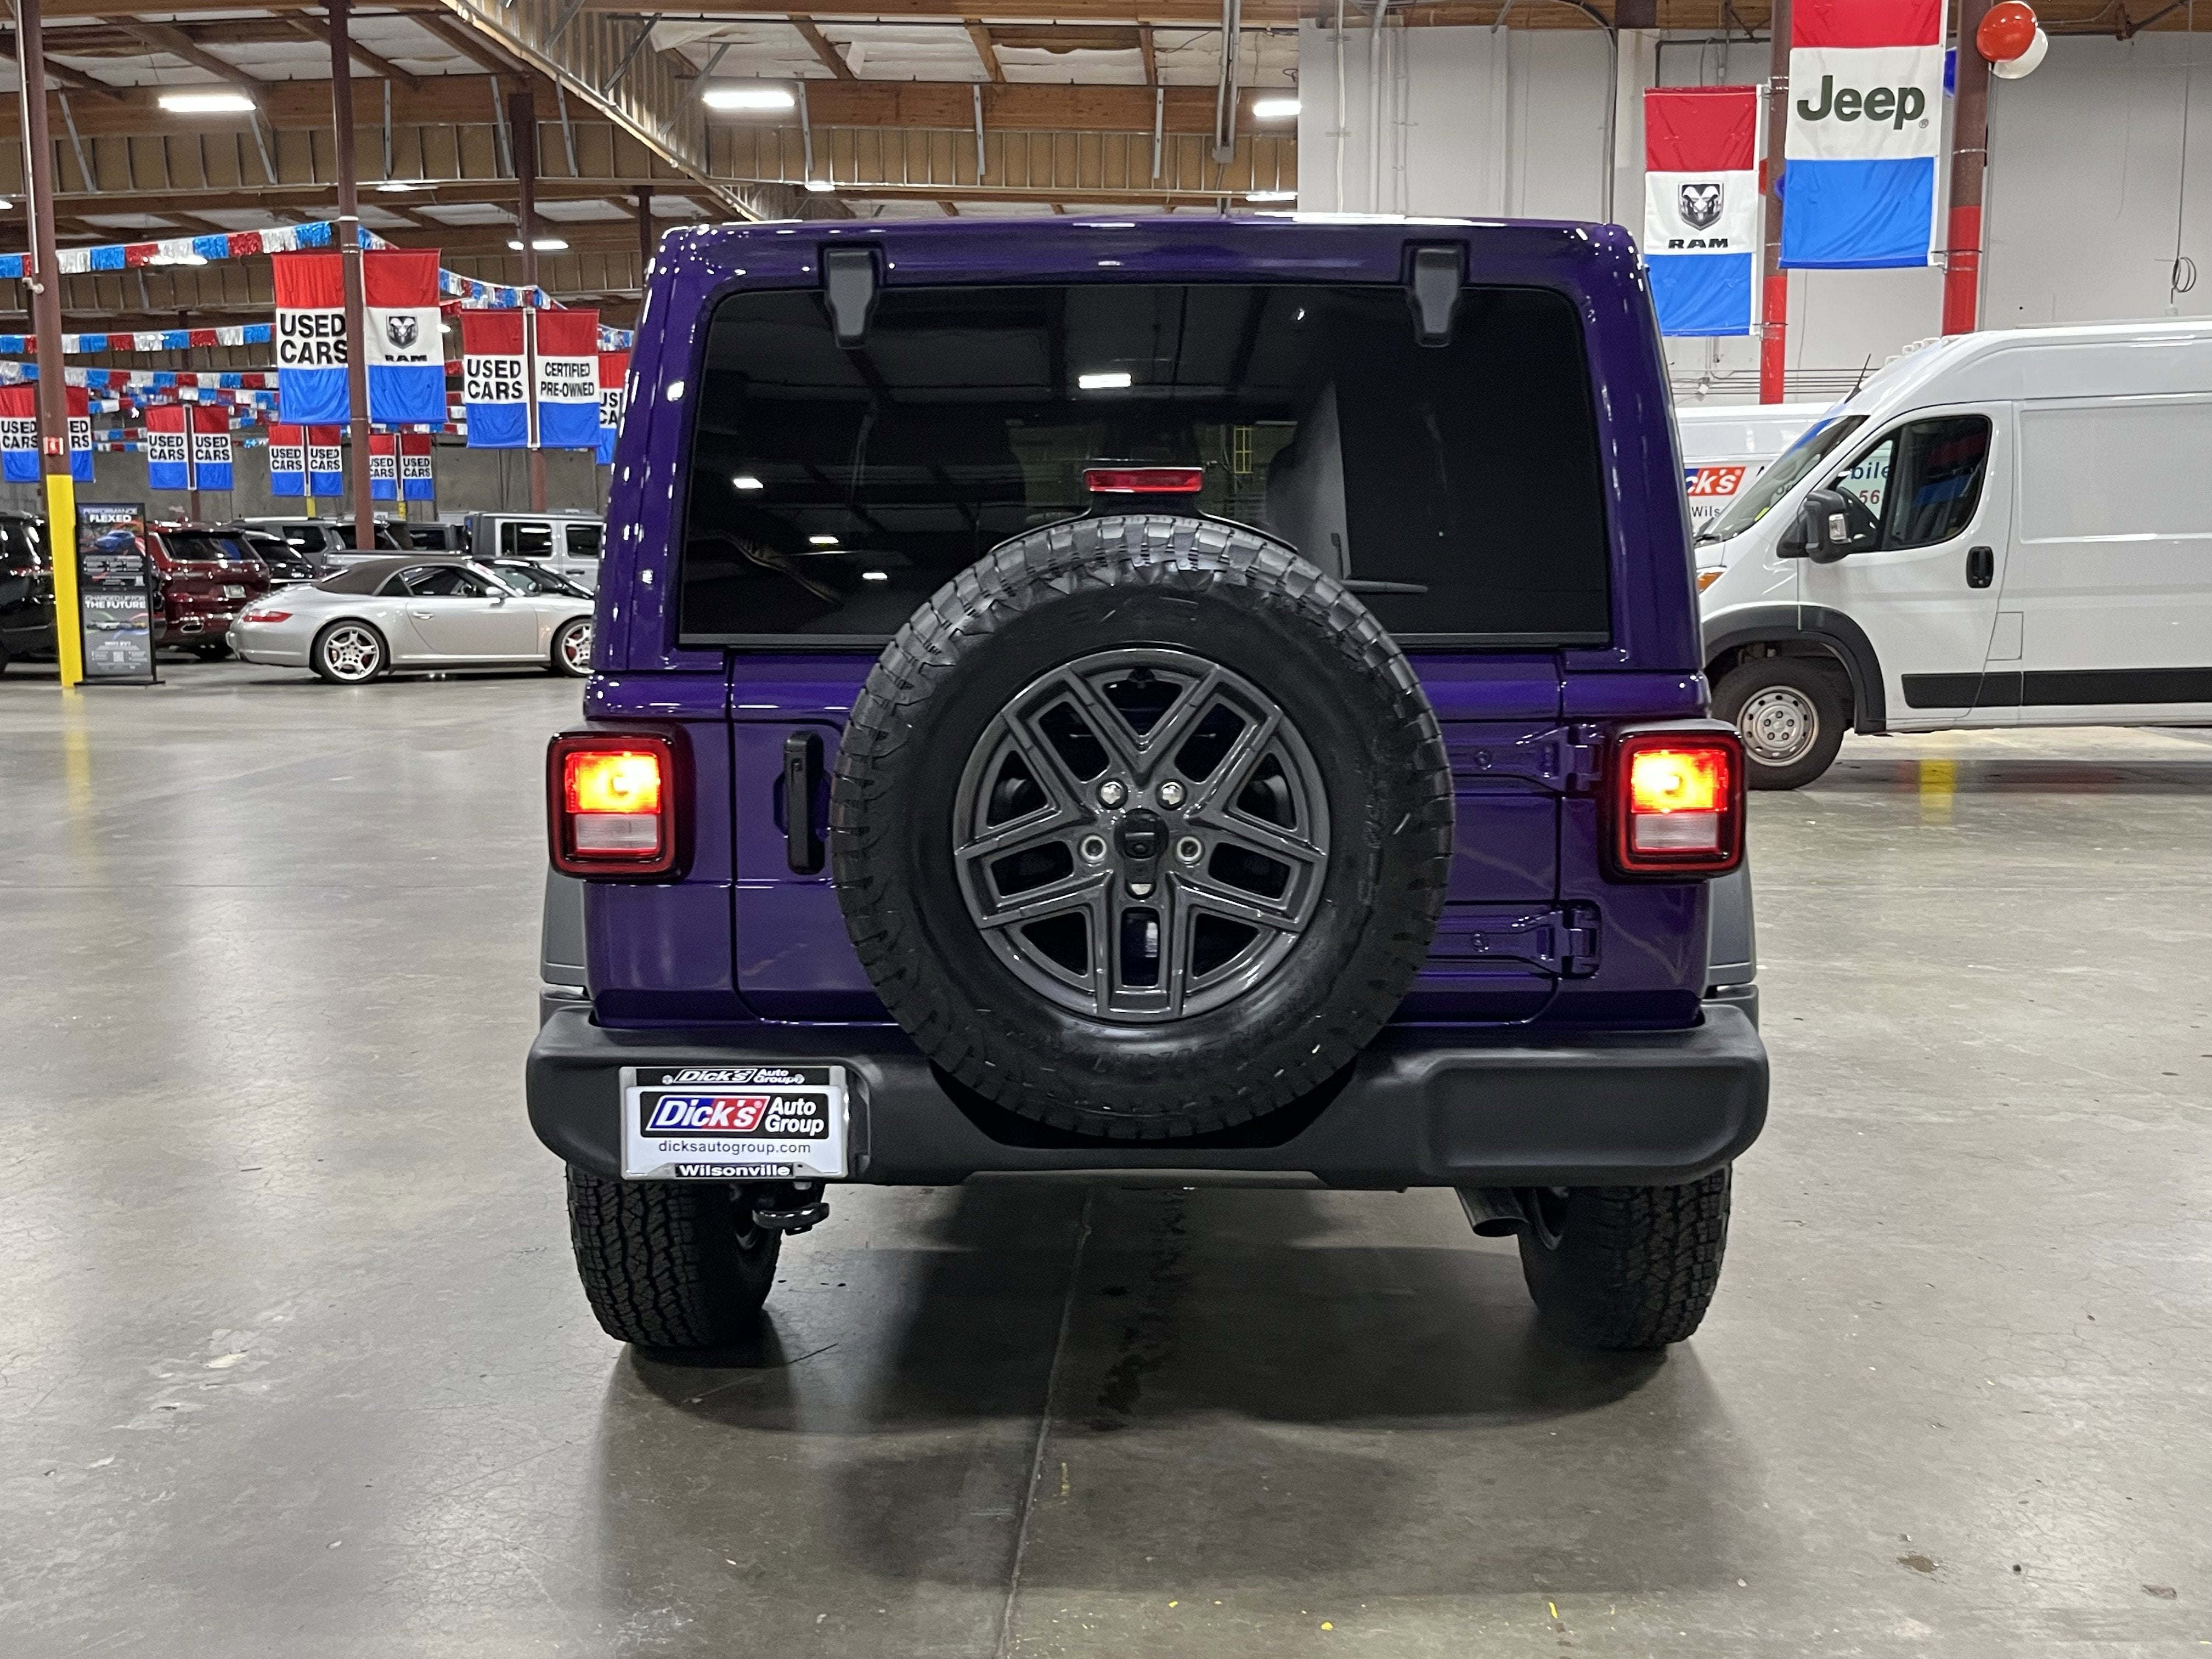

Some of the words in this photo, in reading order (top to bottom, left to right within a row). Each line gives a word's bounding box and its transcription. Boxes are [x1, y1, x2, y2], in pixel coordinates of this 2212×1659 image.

[1796, 75, 1926, 130] Jeep
[1668, 239, 1729, 249] RAM
[280, 314, 346, 338] USED
[280, 340, 348, 364] CARS
[467, 359, 521, 379] USED
[545, 362, 590, 377] CERTIFIED
[467, 380, 523, 400] CARS
[540, 381, 595, 397] PRE-OWNED
[600, 392, 623, 408] US
[600, 409, 618, 425] CA
[1, 420, 37, 434] USED
[70, 420, 88, 433] ED
[2, 435, 38, 449] CARS
[71, 435, 89, 448] RS
[149, 435, 184, 447] USED
[195, 436, 228, 448] USED
[150, 448, 185, 460] CARS
[195, 449, 230, 461] CARS
[271, 448, 301, 458] USED
[311, 448, 340, 459] USED
[272, 460, 302, 470] CARS
[311, 460, 340, 470] CARS
[403, 458, 430, 467] USED
[403, 468, 431, 477] CARS
[679, 1070, 749, 1081] Dick's
[753, 1075, 798, 1084] Group
[757, 1069, 789, 1077] Auto
[655, 1099, 757, 1127] Dick's
[769, 1097, 816, 1116] Auto
[765, 1115, 824, 1137] Group
[658, 1140, 811, 1155] dicksautogroup.com
[678, 1164, 791, 1177] Wilsonville
